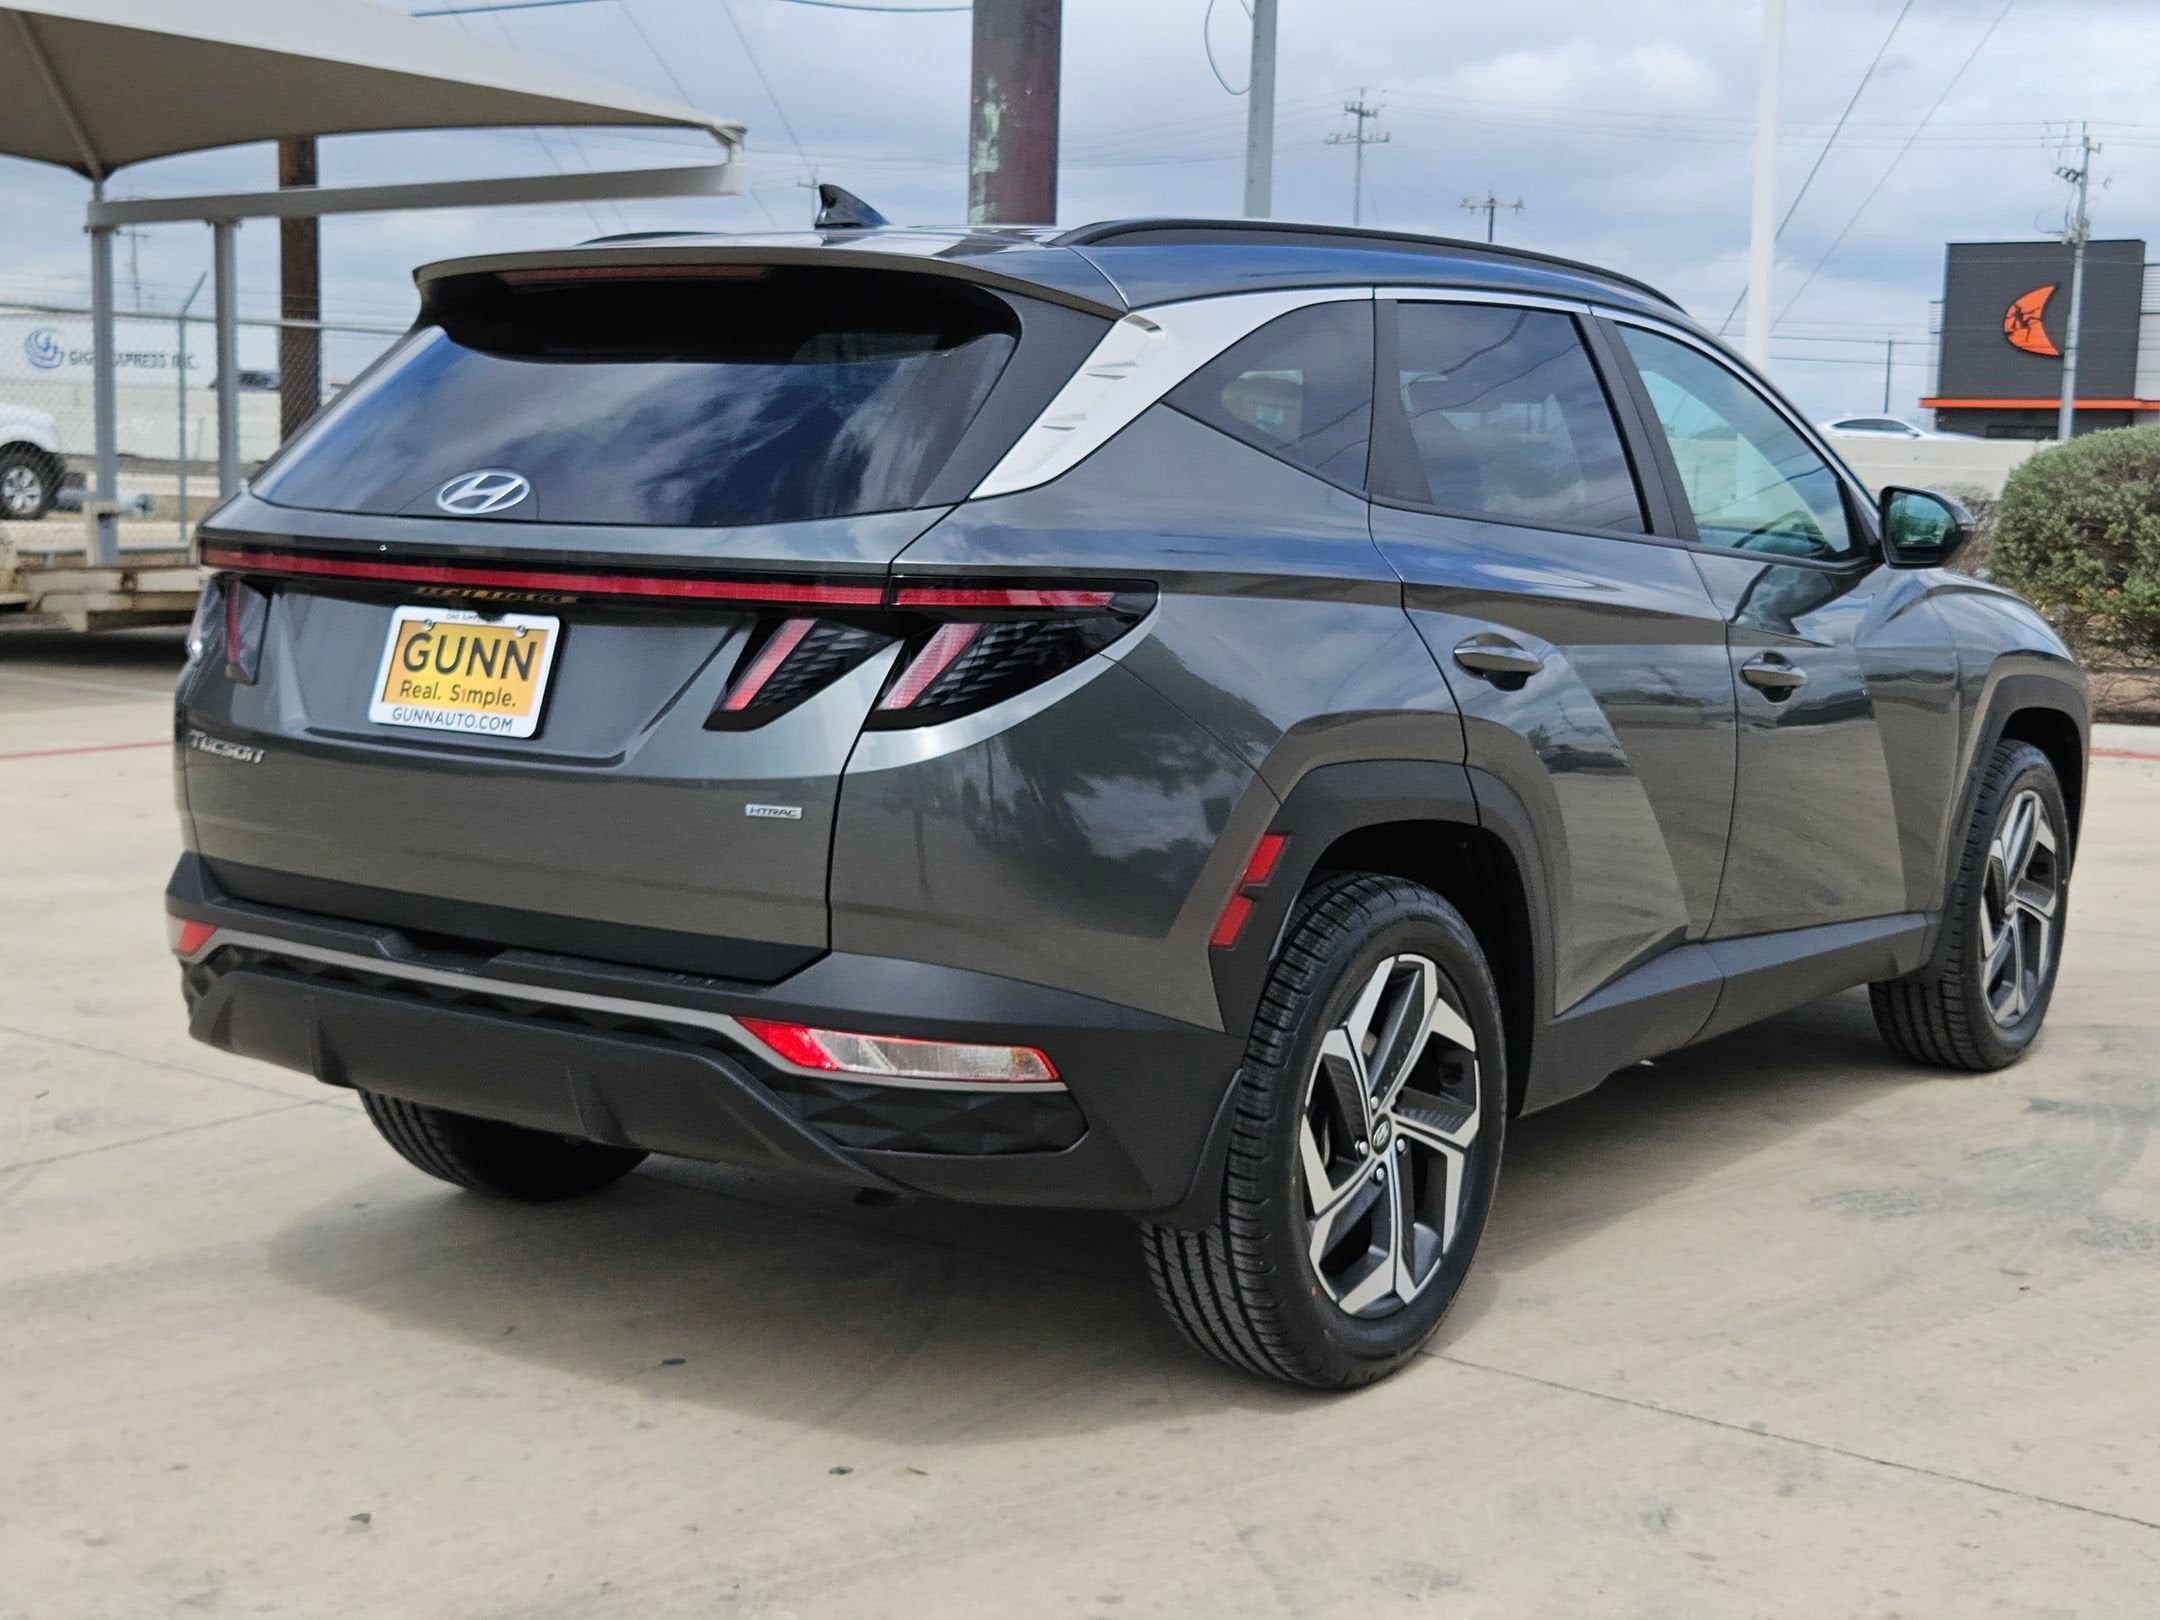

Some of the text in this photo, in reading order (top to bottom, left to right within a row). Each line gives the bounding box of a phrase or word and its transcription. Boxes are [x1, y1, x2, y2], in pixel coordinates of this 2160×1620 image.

[69, 351, 99, 366] GIG
[110, 352, 167, 369] XPRESS
[403, 632, 537, 681] GUNN
[400, 680, 441, 701] Real.
[392, 707, 514, 732] GUNNAUTO.COM
[750, 807, 798, 817] HTRAC
